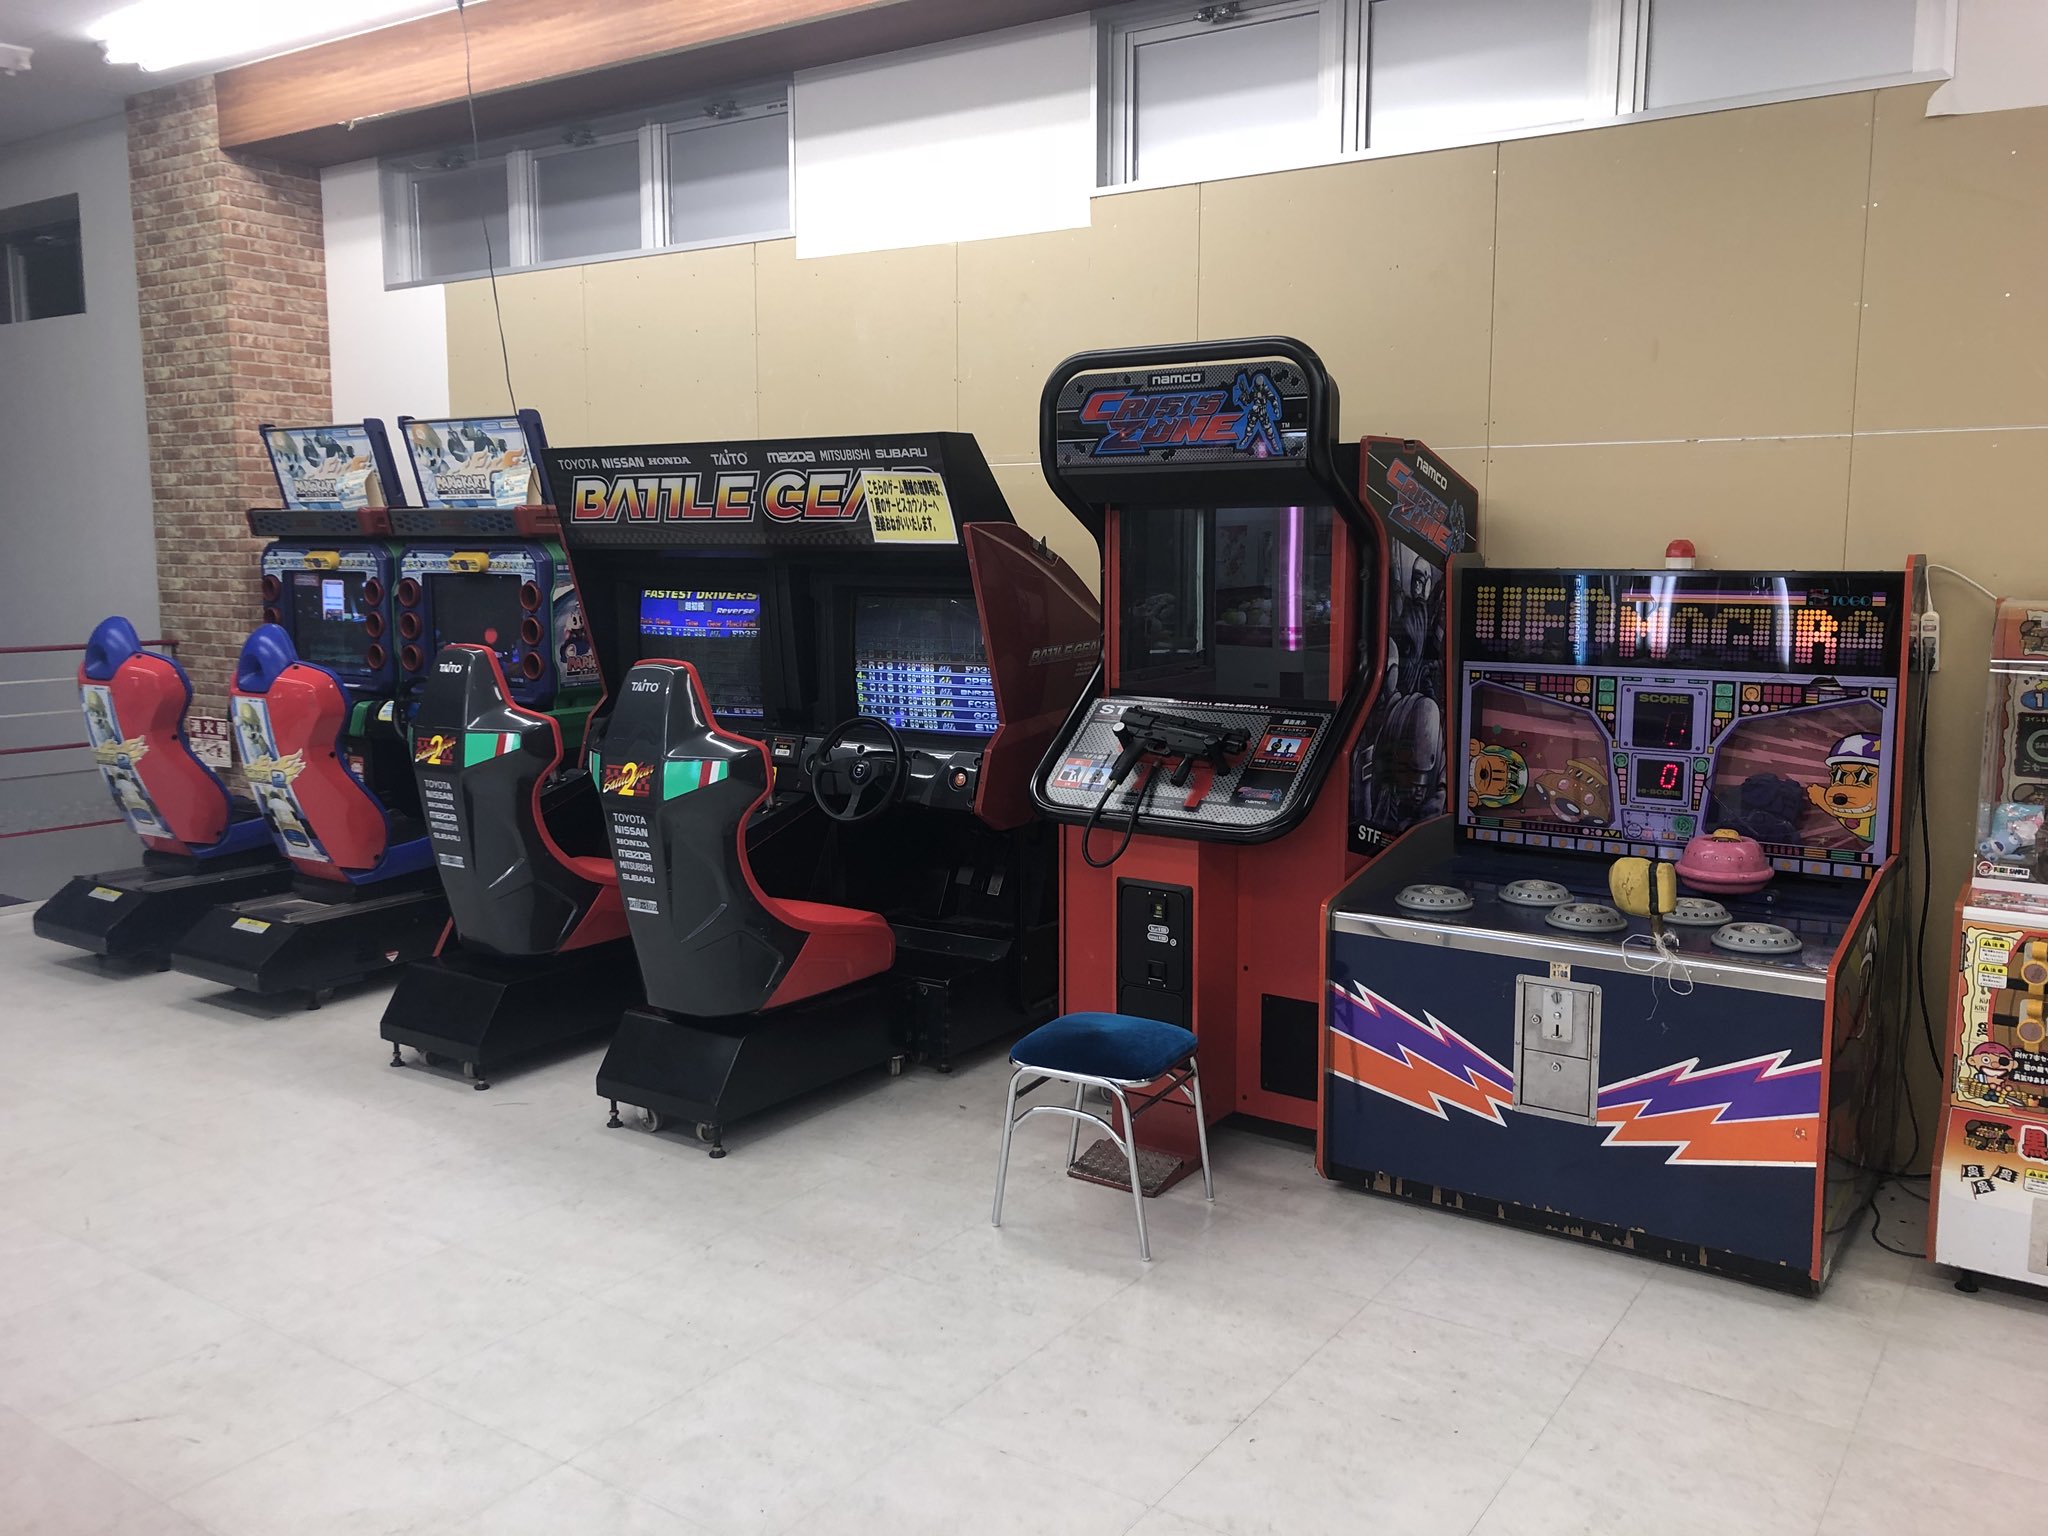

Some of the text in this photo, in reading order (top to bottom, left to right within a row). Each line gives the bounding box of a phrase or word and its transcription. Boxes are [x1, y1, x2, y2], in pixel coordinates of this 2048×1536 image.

[1152, 373, 1202, 386] namco
[1081, 391, 1228, 421] CRISIS
[1098, 414, 1244, 452] ZONE
[558, 458, 599, 470] TOYOTA
[601, 456, 645, 469] NISSAN
[647, 456, 692, 466] HONDA
[710, 449, 748, 466] TAITO
[819, 448, 871, 462] MITSUBISHI
[874, 447, 928, 459] SUBARU
[1416, 455, 1448, 491] namco
[572, 469, 869, 524] BATTLE GEA
[644, 589, 758, 600] FASTEST DRIVERS
[716, 607, 755, 615] Reverse
[631, 679, 660, 693] TAITO
[1638, 694, 1689, 704] SCORE
[190, 719, 227, 735] 消火器
[618, 762, 638, 796] 2
[1660, 763, 1679, 790] 0
[424, 779, 452, 790] TOYOTA
[426, 790, 454, 801] NISSAN
[613, 812, 647, 826] TOYOTA
[614, 825, 648, 838] NISSAN
[1358, 824, 1382, 845] STF
[616, 838, 650, 849] HONDA
[619, 860, 653, 873] MITSUBISHI
[622, 873, 656, 885] SUBARU
